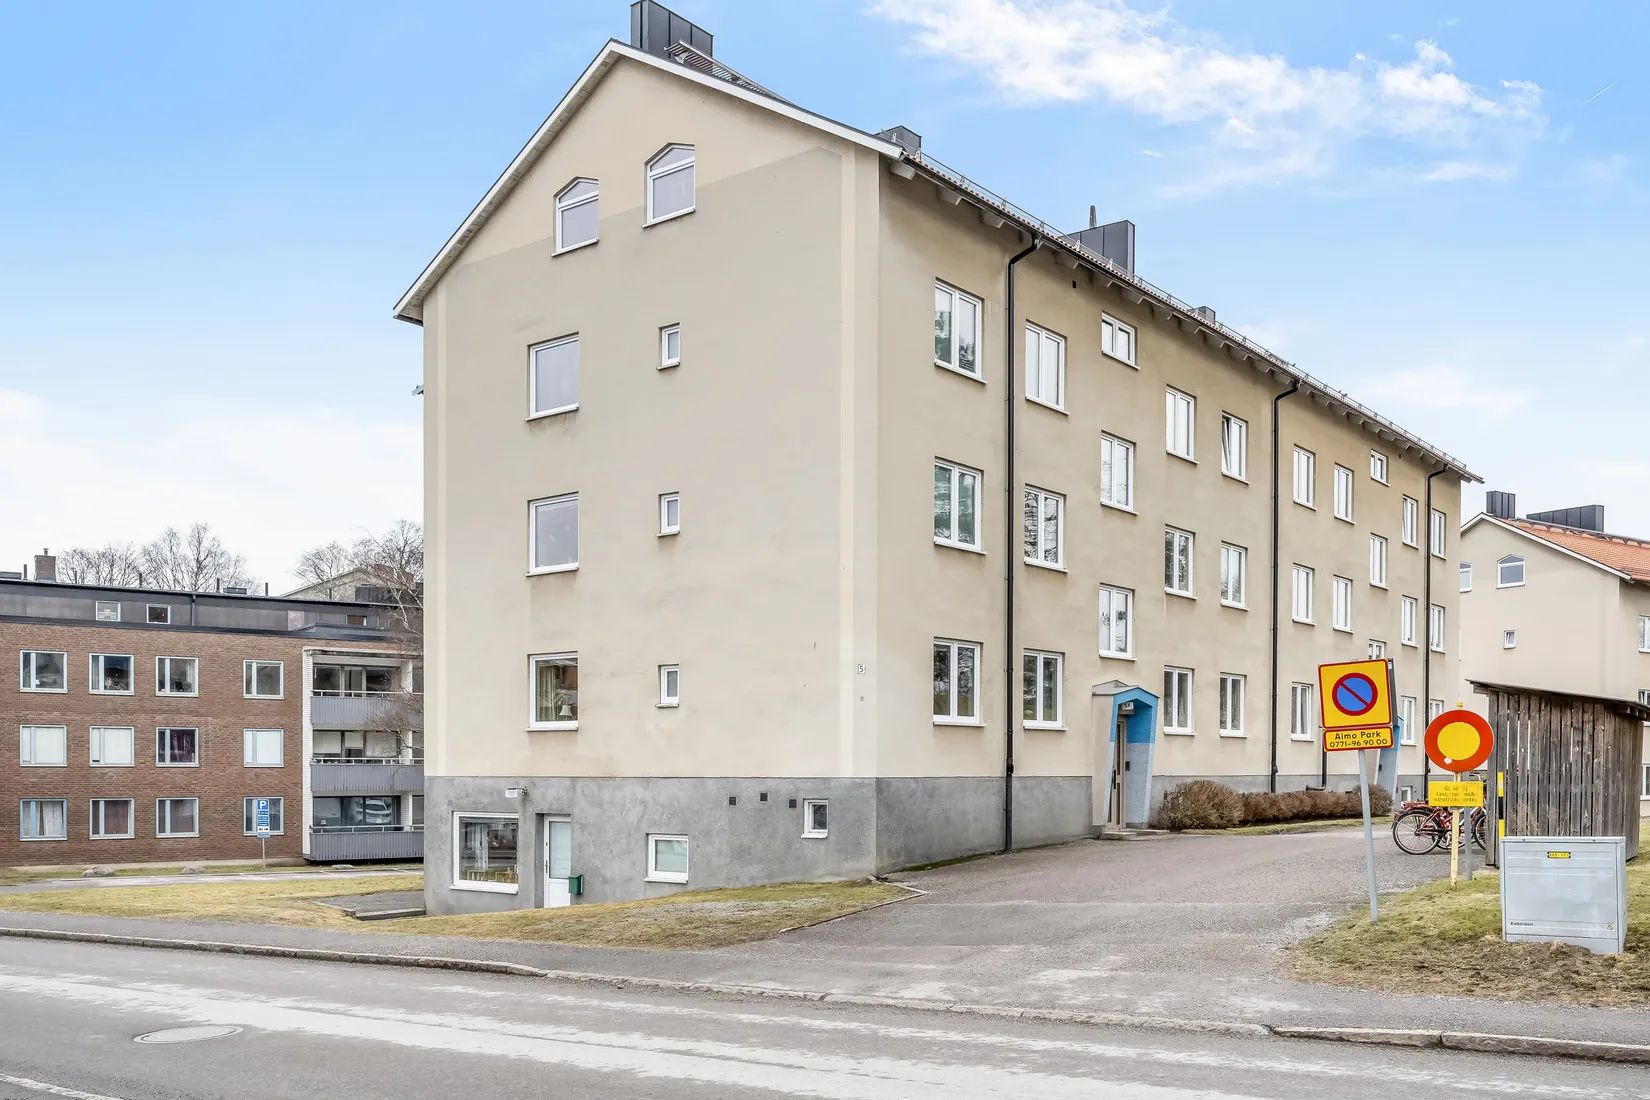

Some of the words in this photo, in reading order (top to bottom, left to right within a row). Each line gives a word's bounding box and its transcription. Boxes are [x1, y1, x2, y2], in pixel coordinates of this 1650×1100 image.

[1335, 732, 1357, 740] Aimo
[1330, 740, 1361, 748] 0771-96
[259, 800, 267, 809] P
